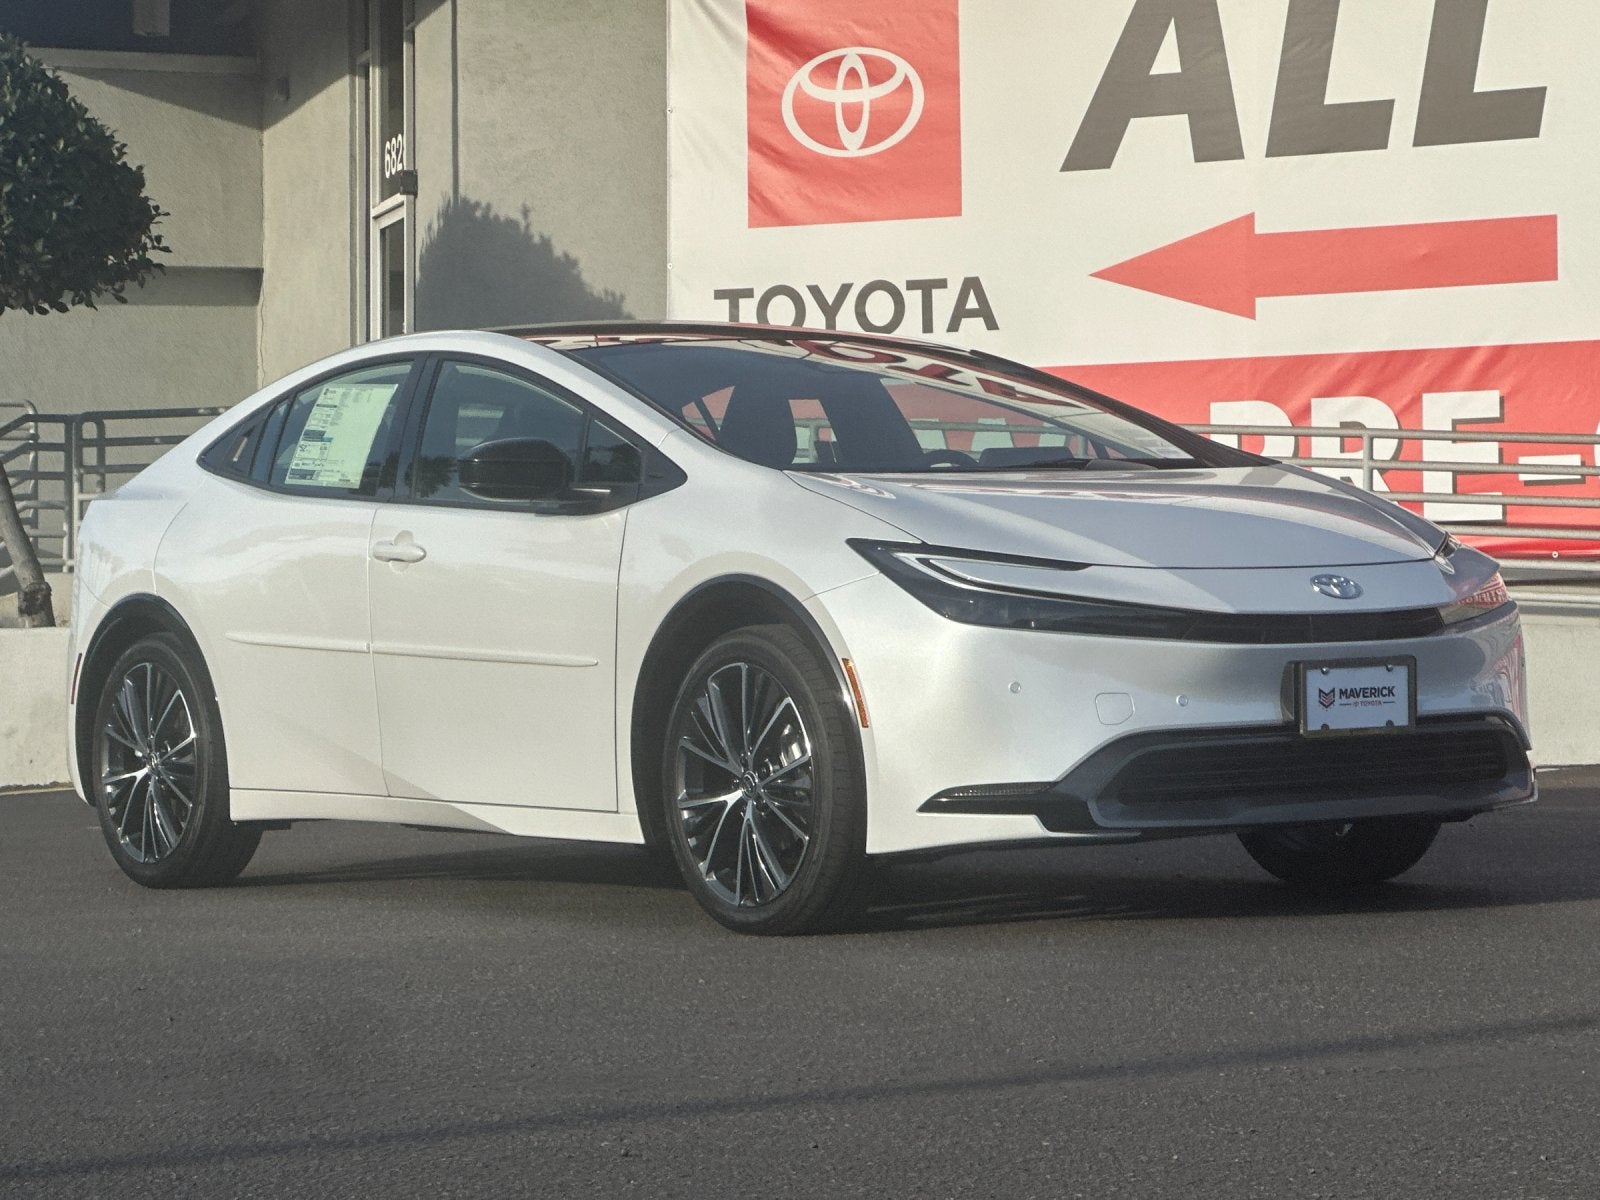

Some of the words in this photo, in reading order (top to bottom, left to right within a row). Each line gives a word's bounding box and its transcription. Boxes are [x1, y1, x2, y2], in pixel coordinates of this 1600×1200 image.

[1060, 0, 1547, 172] ALL
[384, 133, 403, 179] 682
[713, 276, 1000, 334] TOYOTA
[1210, 390, 1600, 522] PRE-
[1339, 686, 1395, 699] MAVERICK
